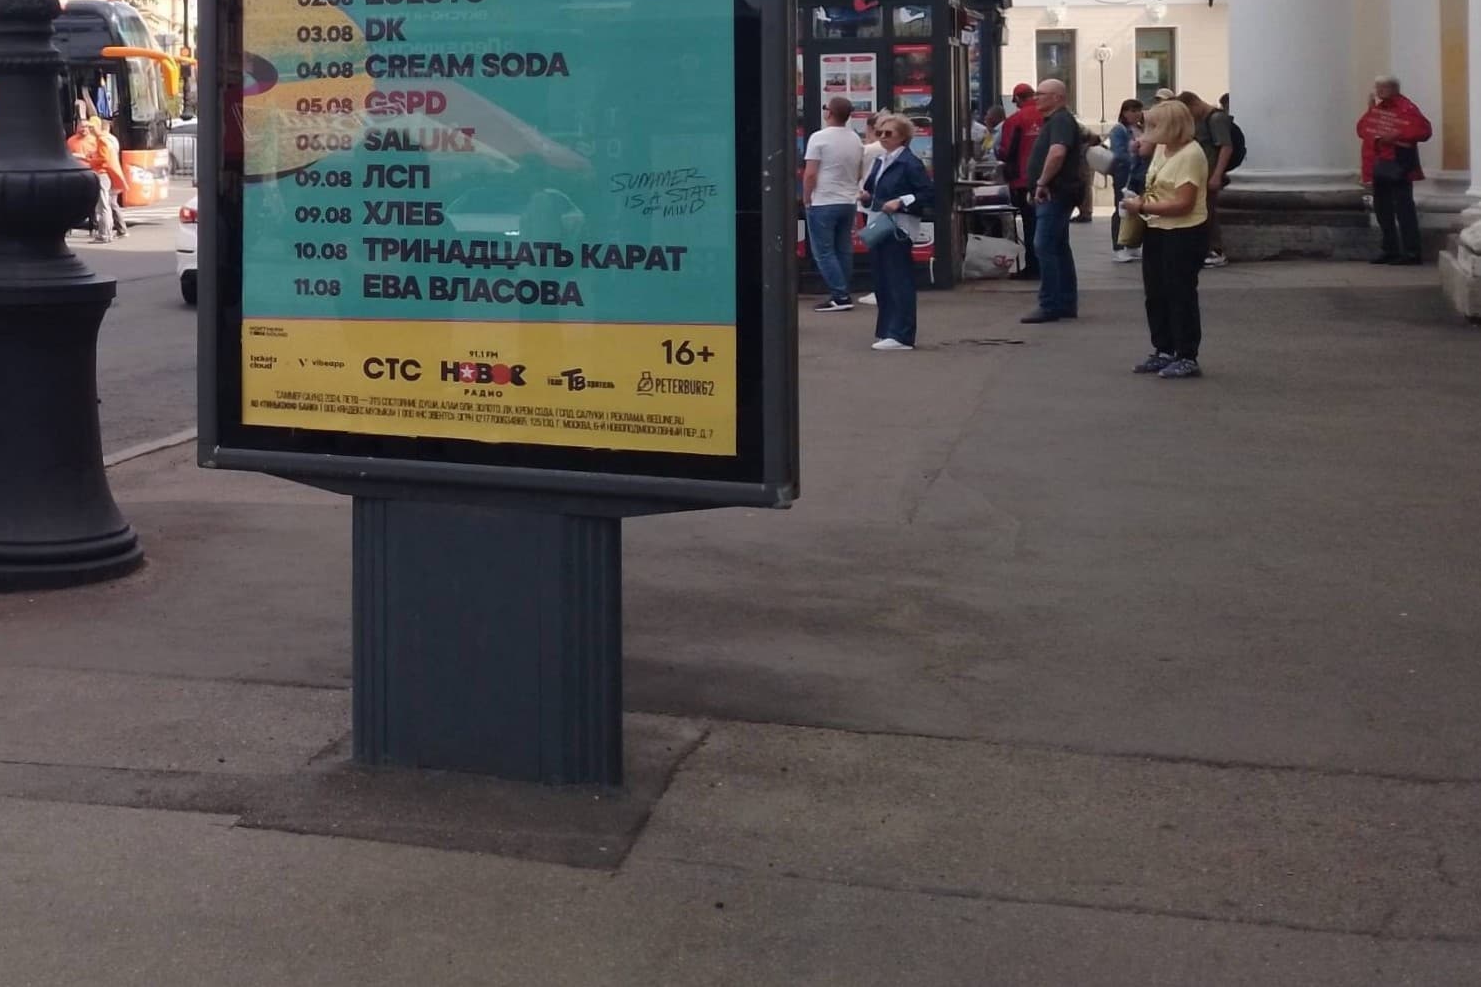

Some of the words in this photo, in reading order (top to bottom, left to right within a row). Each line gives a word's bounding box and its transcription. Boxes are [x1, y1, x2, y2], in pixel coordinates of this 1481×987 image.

[297, 26, 354, 43] 03.08
[365, 18, 407, 42] DK
[296, 62, 354, 79] 04.08
[365, 53, 474, 79] CREAM
[481, 52, 570, 77] SODA
[296, 98, 353, 114] 05.08
[364, 90, 447, 115] GSPD
[295, 134, 353, 151] 06.08
[363, 127, 476, 152] SALUKI
[295, 170, 352, 188] 09.08
[363, 165, 430, 189] ЛСП
[610, 167, 706, 193] SUMMER
[624, 194, 645, 209] IS
[664, 184, 718, 203] STATE
[663, 199, 705, 218] MIND
[295, 207, 352, 224] 09.08
[363, 201, 444, 226] ХЛЕБ
[294, 243, 347, 260] 10.08
[363, 238, 573, 270] ТРИНАДЦАТЬ
[582, 244, 687, 271] КАРАТ
[294, 279, 341, 296] 11.08
[363, 274, 423, 300] ЕВА
[429, 276, 583, 307] ВЛАСОВА
[661, 340, 714, 365] 16+
[363, 357, 422, 381] СТС
[464, 389, 503, 398] РАДИО
